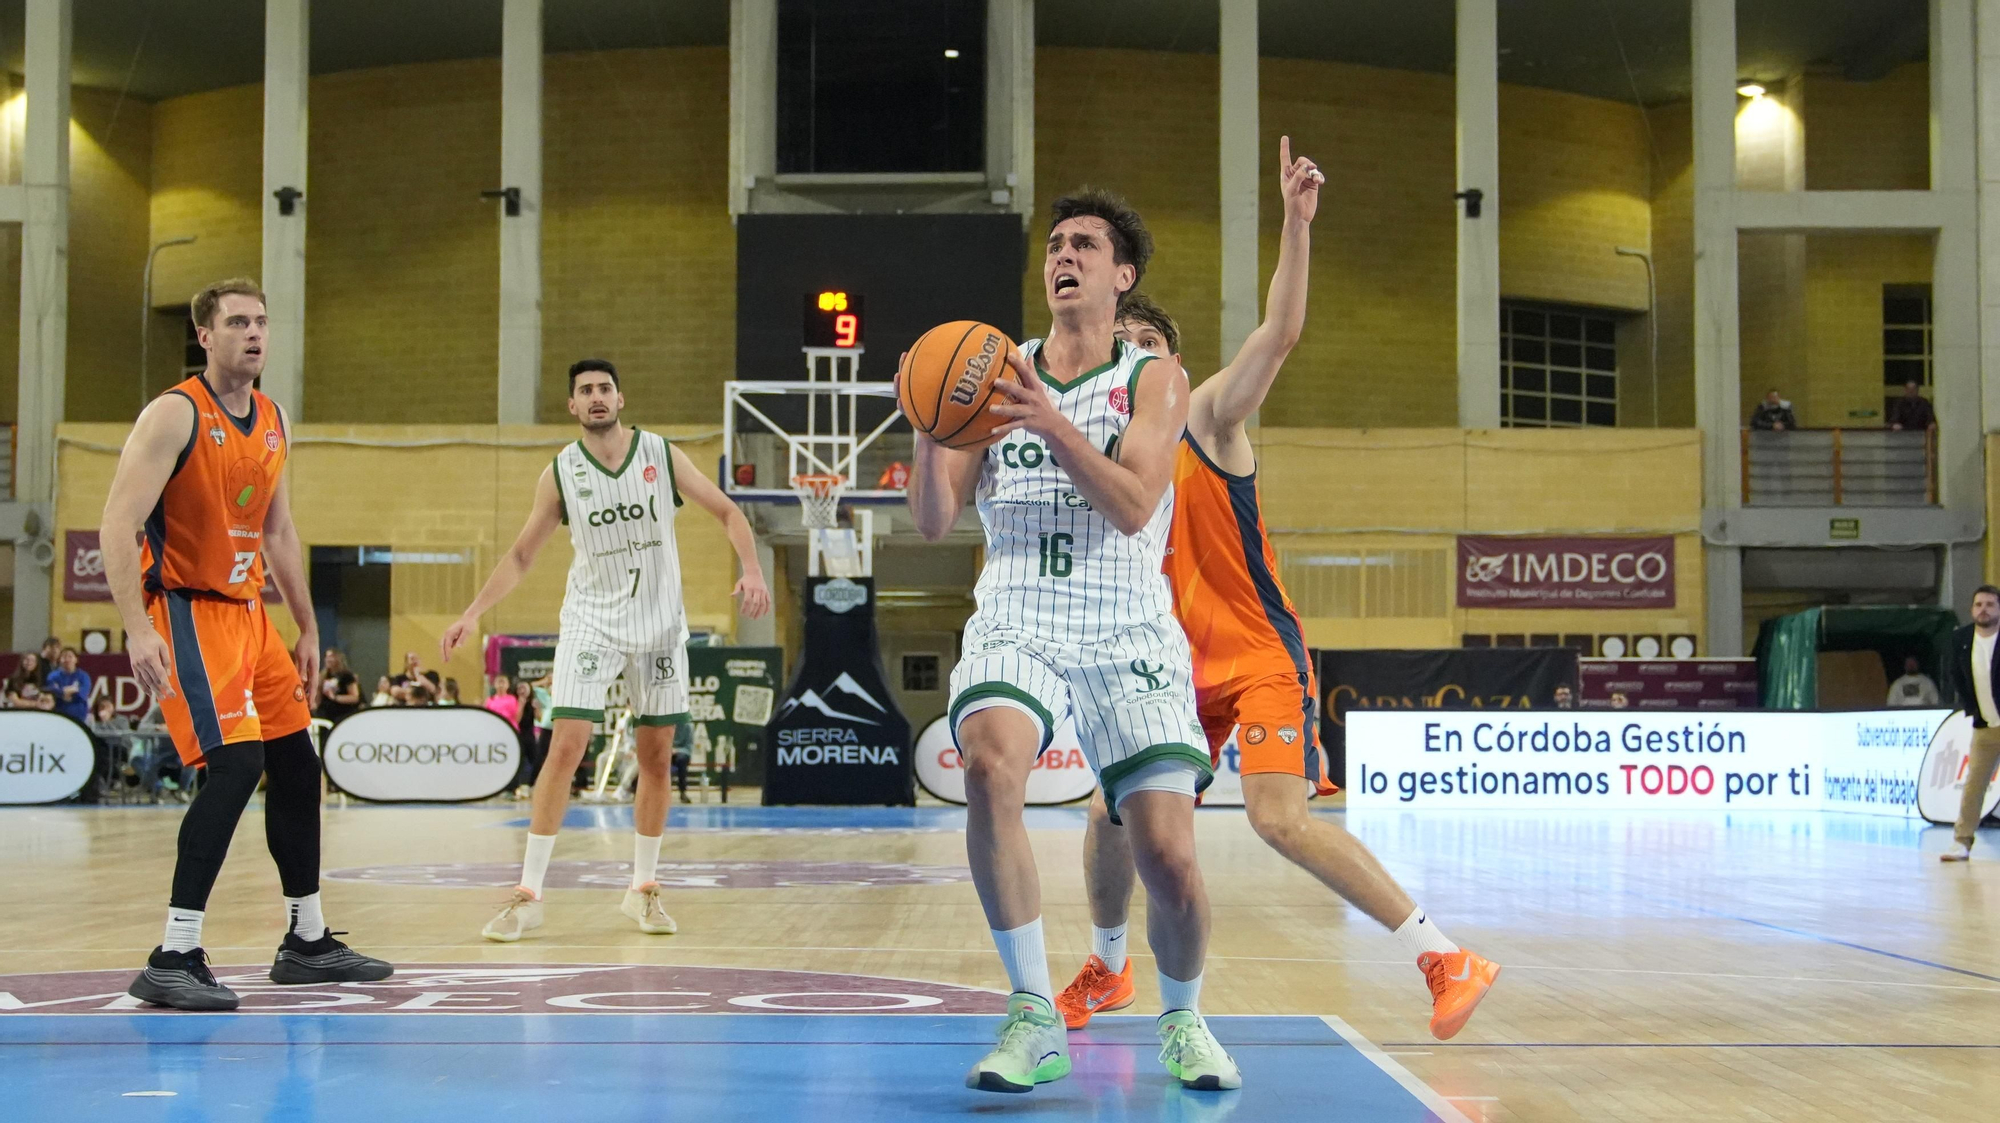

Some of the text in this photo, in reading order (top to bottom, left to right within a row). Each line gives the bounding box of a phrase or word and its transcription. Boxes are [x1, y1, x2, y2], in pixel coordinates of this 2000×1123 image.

[836, 314, 857, 347] 9
[949, 332, 1001, 406] Wilson
[588, 502, 645, 527] coto
[1038, 532, 1074, 578] 16
[1512, 552, 1667, 583] IMDECO
[628, 568, 640, 598] 7
[777, 728, 859, 746] SIERRA
[1425, 722, 1746, 753] En Córdoba Gestión
[0, 743, 66, 774] alix
[777, 745, 899, 766] MORENA
[1361, 763, 1810, 803] lo gestionamos TODO por ti
